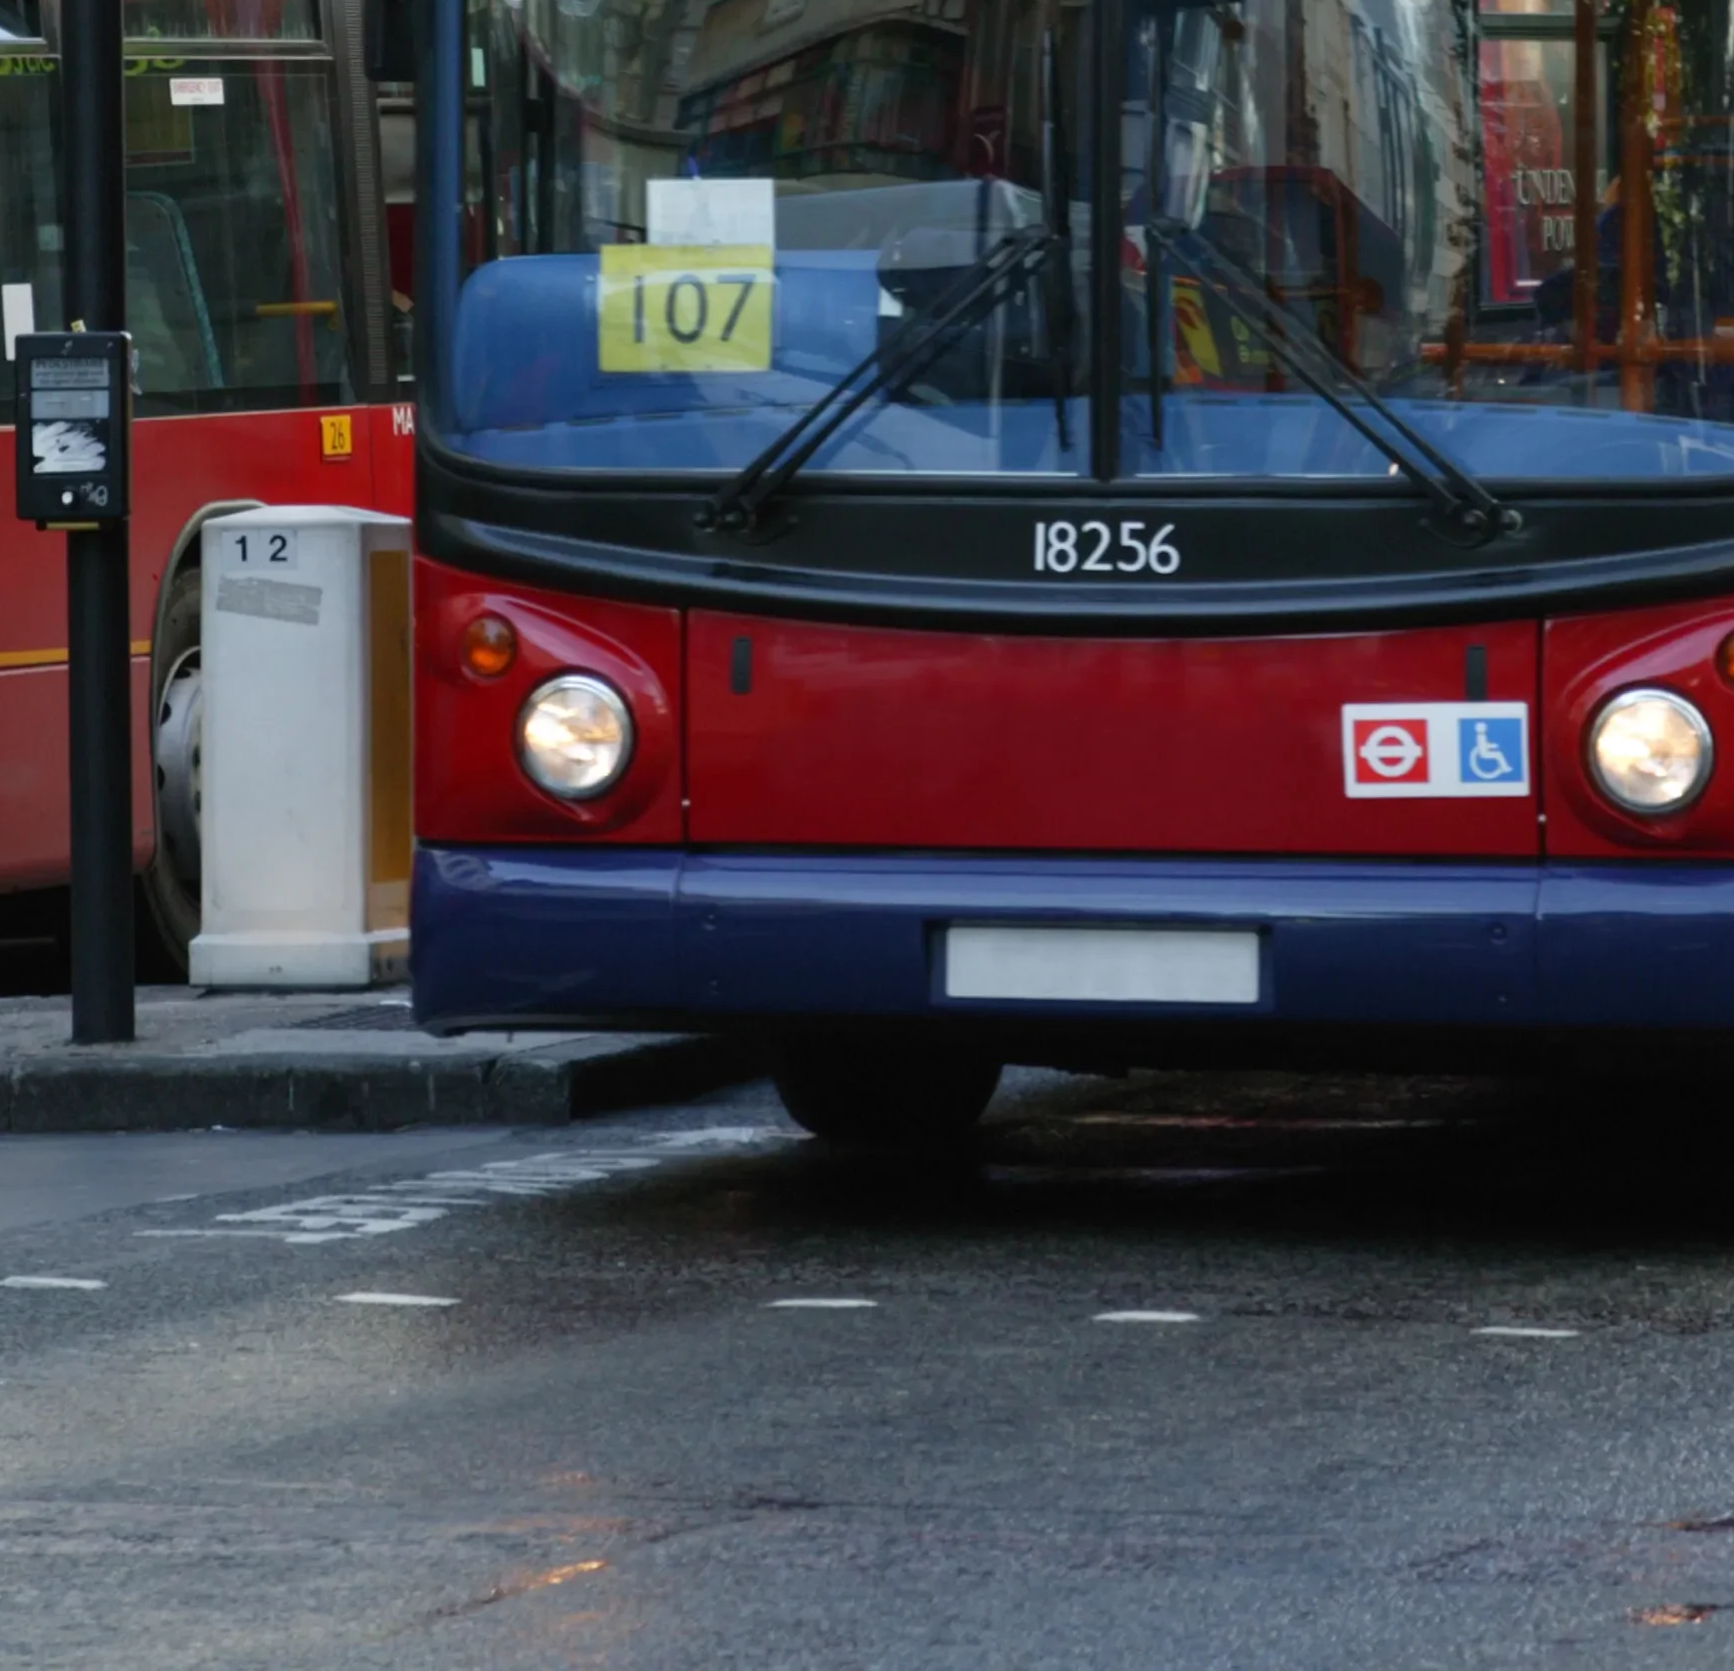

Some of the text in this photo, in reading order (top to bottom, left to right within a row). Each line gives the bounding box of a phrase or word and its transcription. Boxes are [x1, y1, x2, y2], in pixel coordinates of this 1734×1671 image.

[632, 273, 757, 343] 107
[330, 421, 346, 450] 26
[235, 534, 289, 562] 1 2
[1034, 520, 1181, 575] 18256
